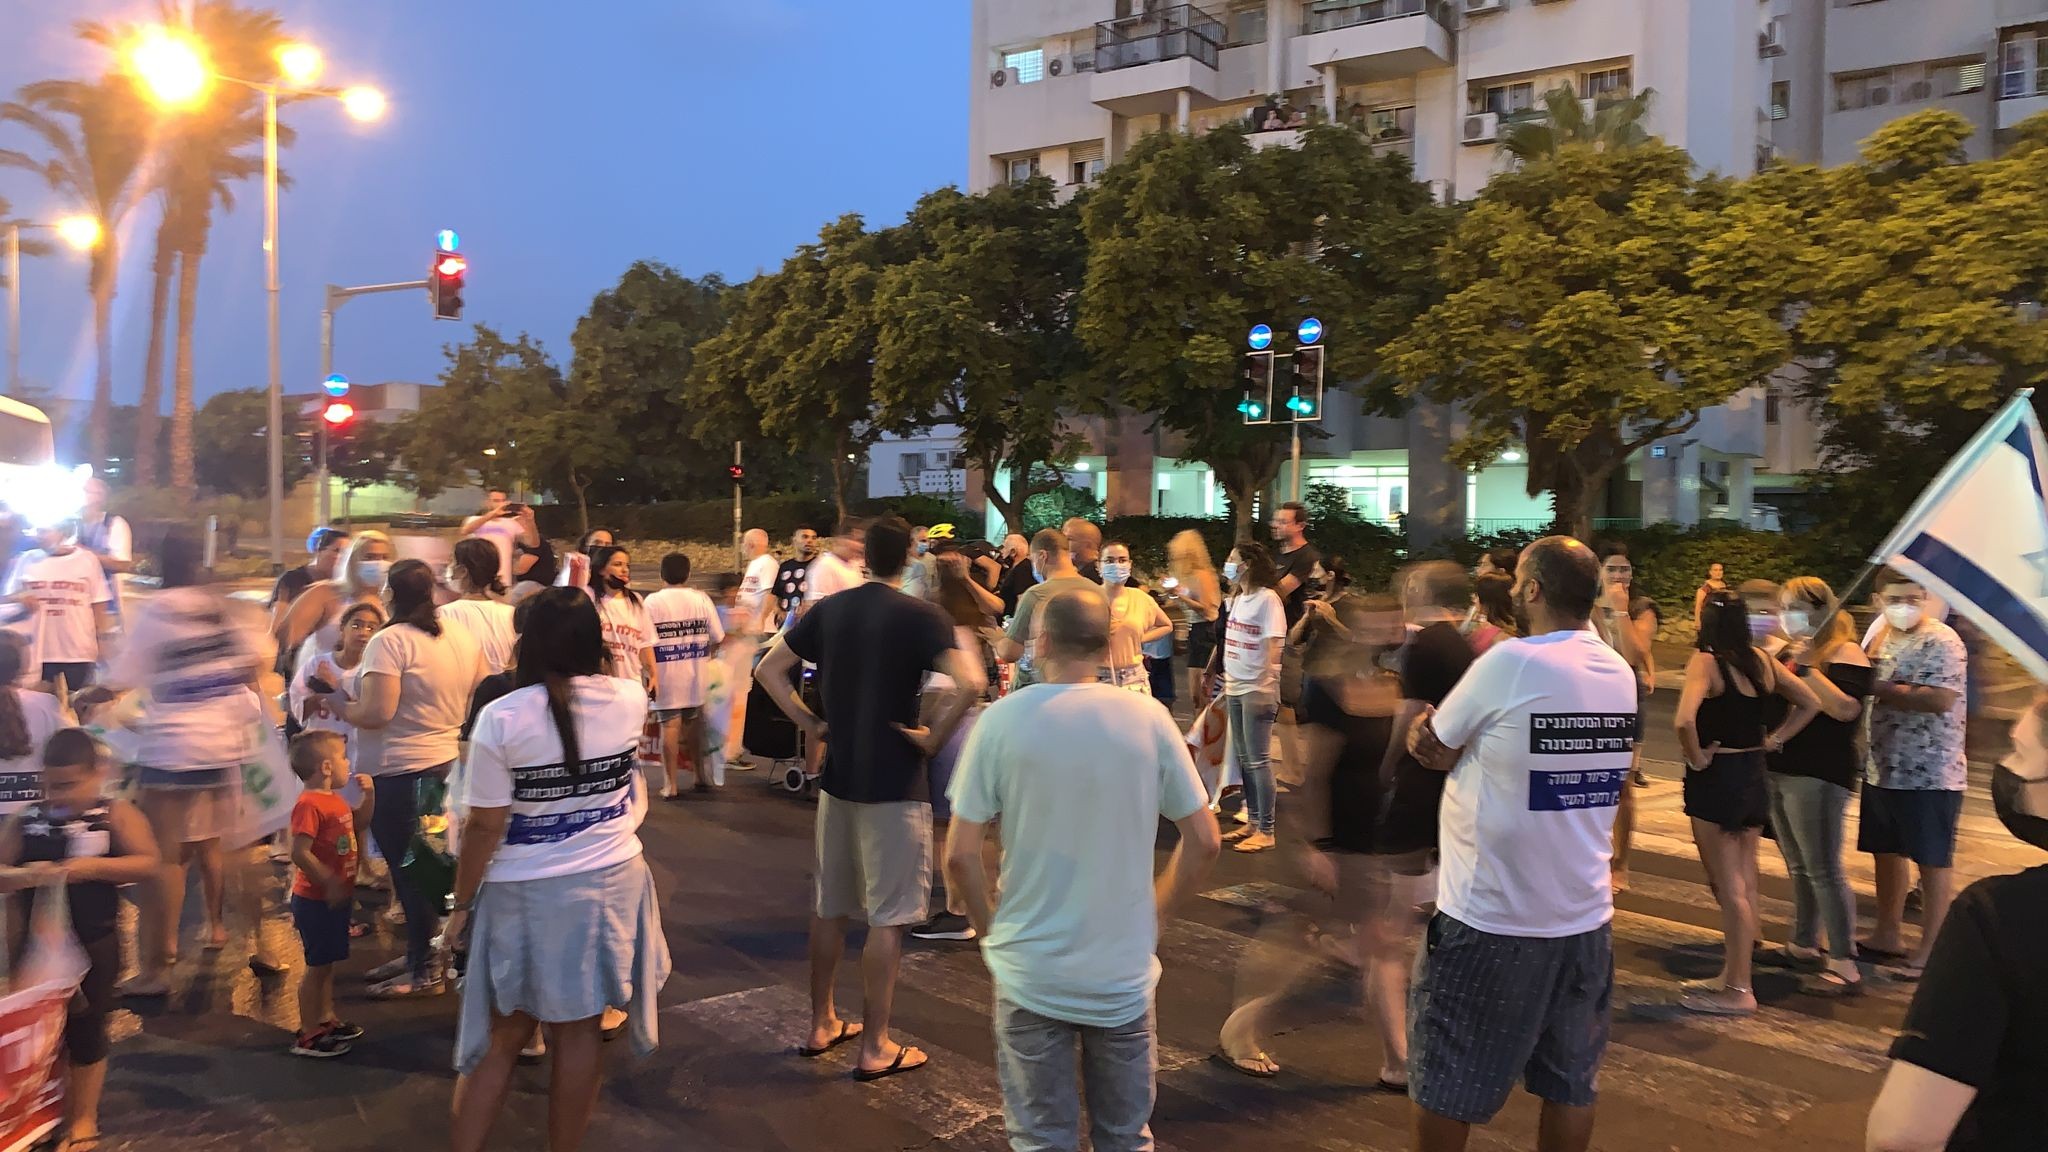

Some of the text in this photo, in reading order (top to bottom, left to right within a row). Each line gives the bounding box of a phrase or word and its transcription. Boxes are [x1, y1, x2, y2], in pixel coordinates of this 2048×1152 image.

[1535, 717, 1601, 729] המסתננים
[1540, 739, 1593, 750] בשכונה
[1548, 773, 1581, 785] שווה
